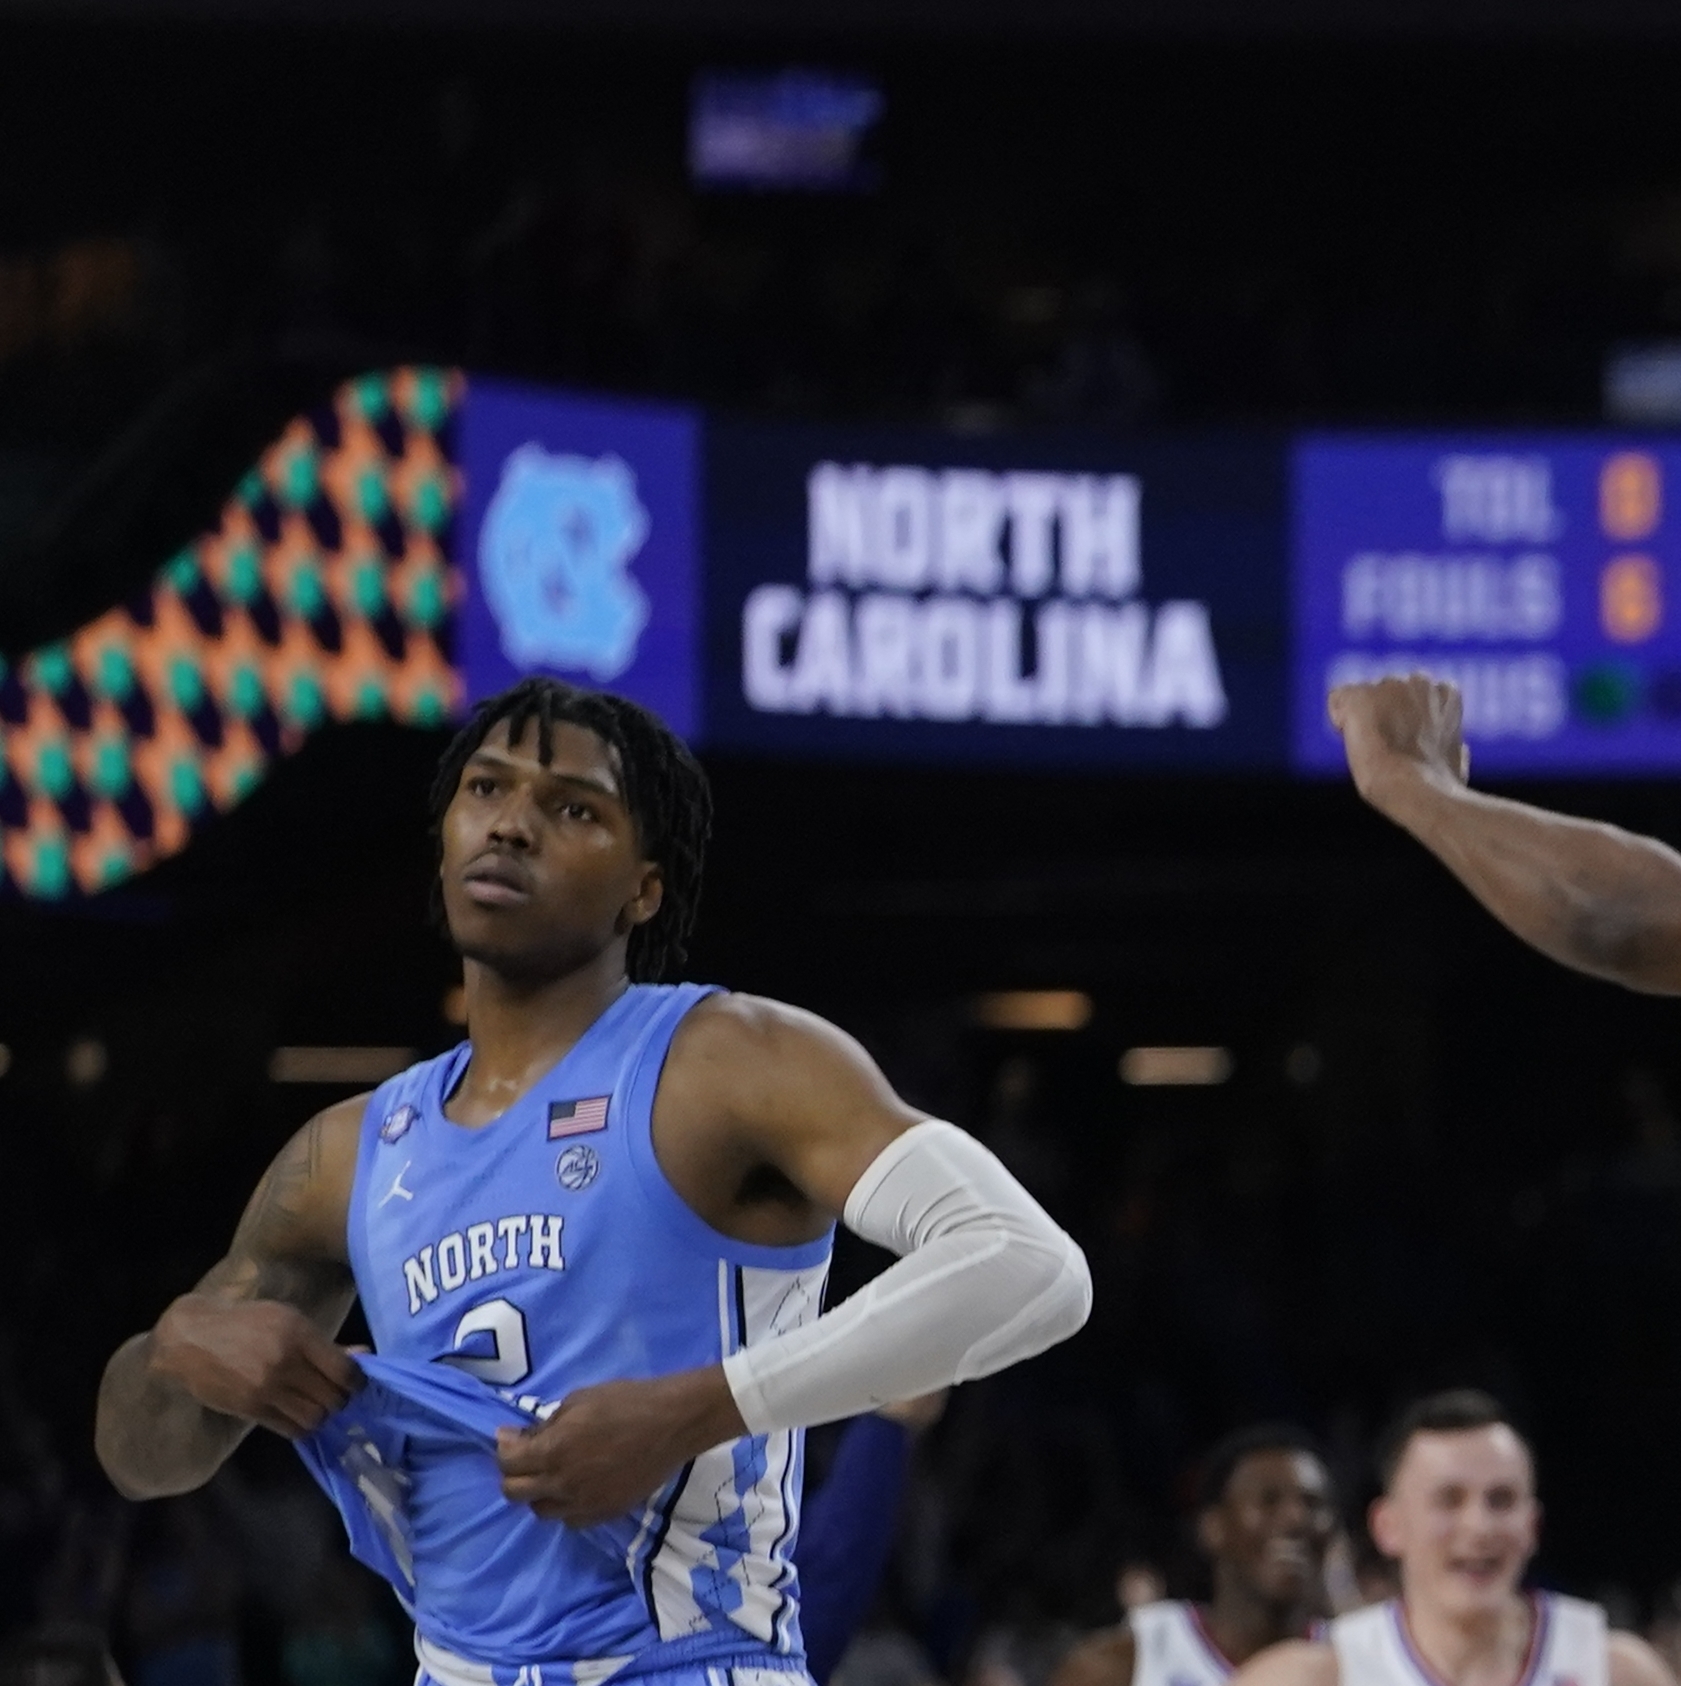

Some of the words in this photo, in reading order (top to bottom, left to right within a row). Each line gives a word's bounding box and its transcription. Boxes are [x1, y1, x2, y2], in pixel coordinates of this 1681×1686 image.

[808, 461, 1142, 597] NORTH
[1342, 551, 1562, 640] FOULS
[742, 583, 1228, 729] CAROLINA
[402, 1214, 566, 1316] NORTH
